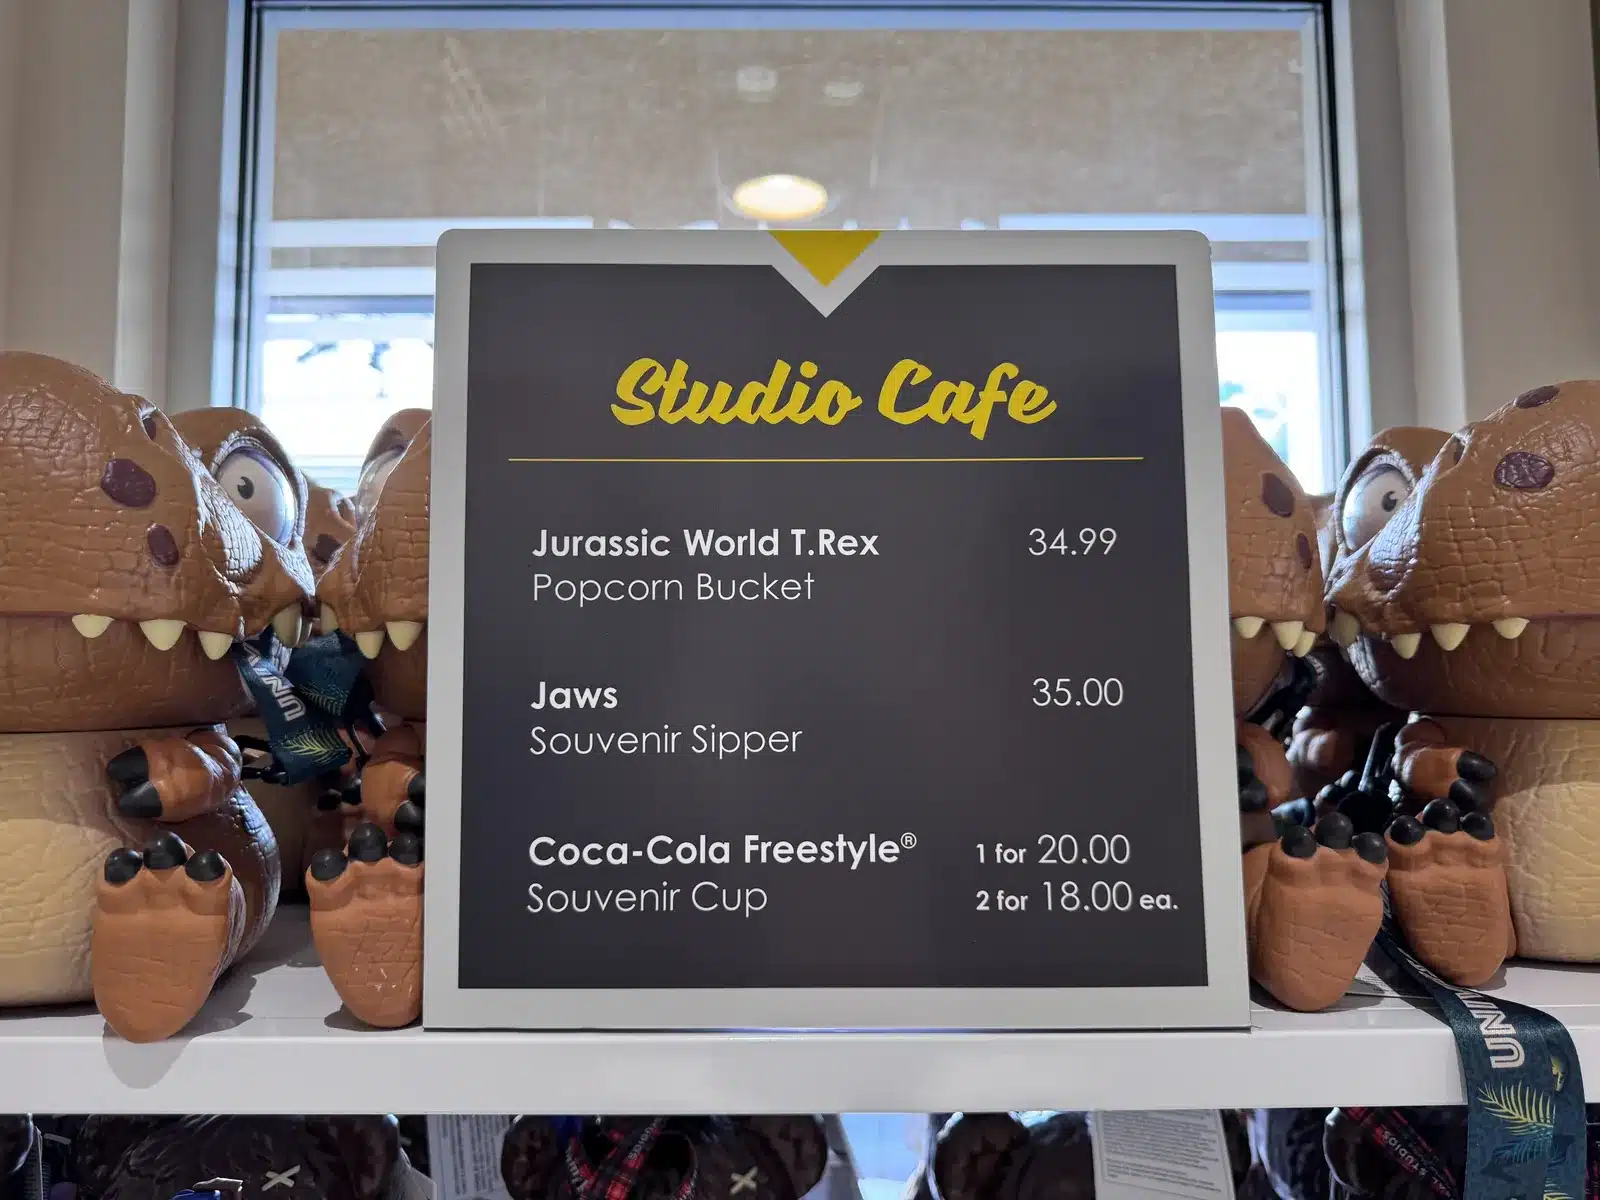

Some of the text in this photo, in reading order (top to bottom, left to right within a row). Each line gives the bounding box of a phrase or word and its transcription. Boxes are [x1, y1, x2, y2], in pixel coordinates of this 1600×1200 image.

[611, 358, 1058, 441] Studio Cafe
[532, 527, 880, 557] Jurassic World T.Rex
[1028, 527, 1118, 556] 34.99
[533, 571, 815, 608] Popcorn Bucket
[530, 681, 618, 710] Jaws
[1032, 677, 1124, 707] 35.00
[529, 723, 803, 760] Souvenir Sipper
[528, 834, 732, 866] Coca-Cola
[976, 833, 1131, 865] 1 for 20.00
[527, 881, 768, 917] Souvenir Cup
[975, 880, 1178, 912] 2 for 18.00 ea.
